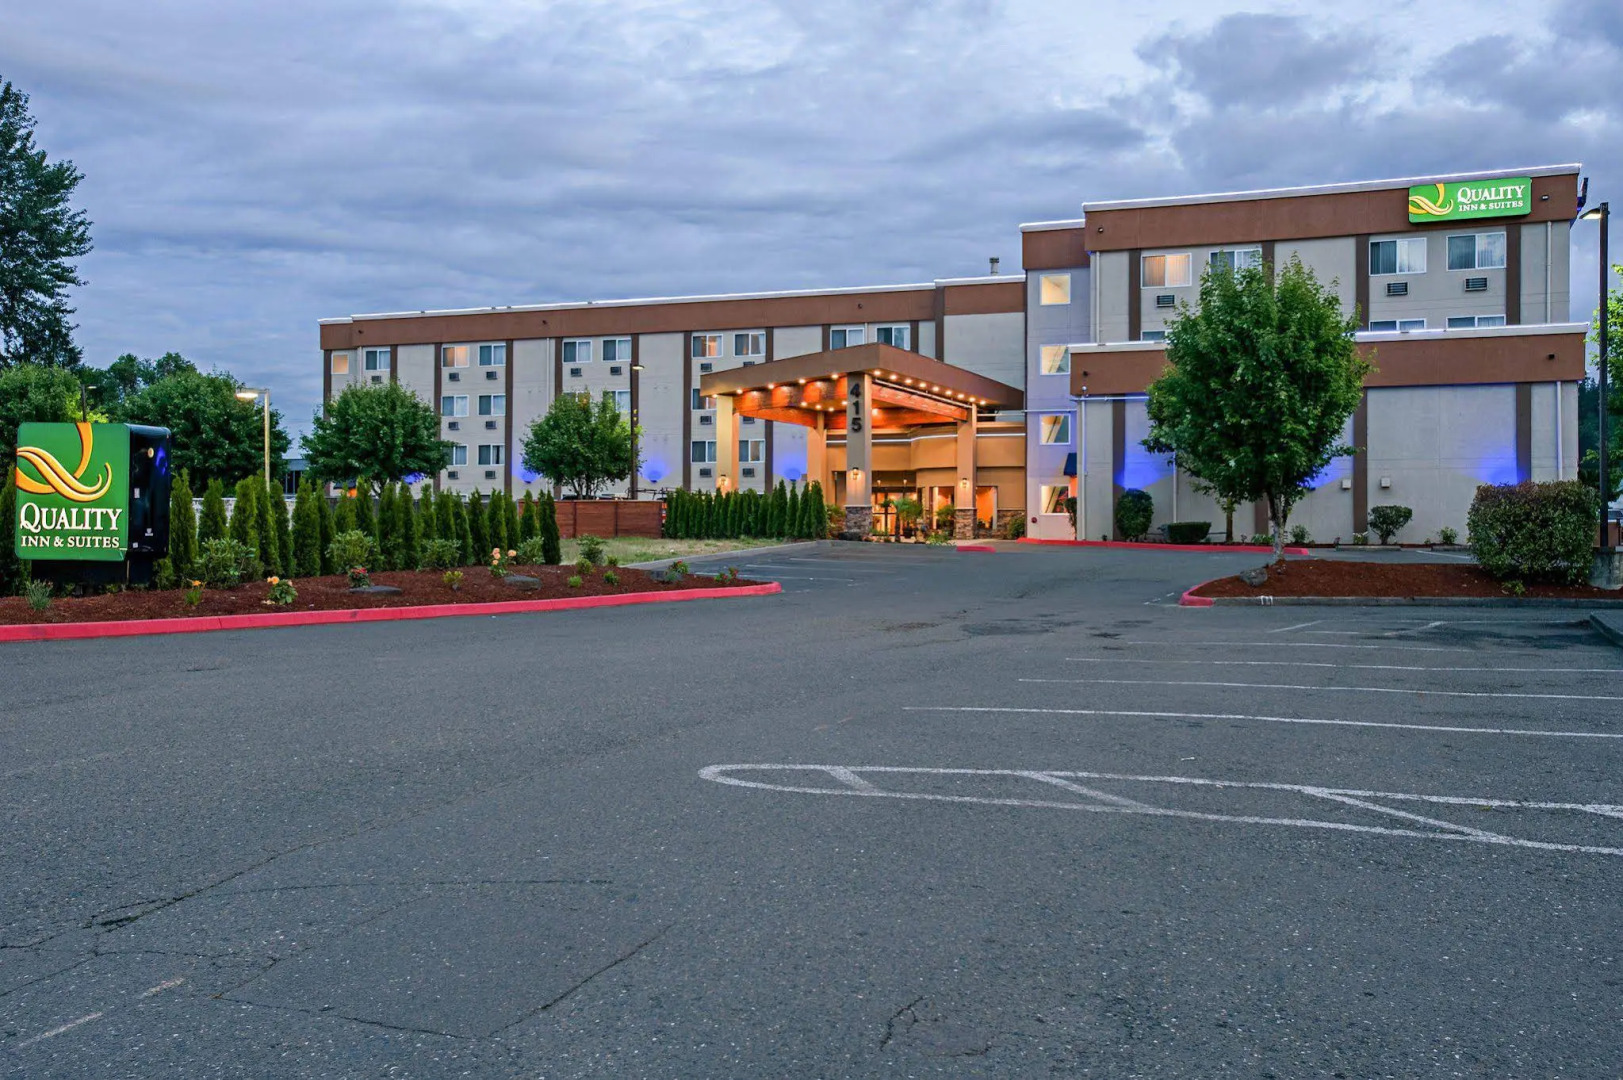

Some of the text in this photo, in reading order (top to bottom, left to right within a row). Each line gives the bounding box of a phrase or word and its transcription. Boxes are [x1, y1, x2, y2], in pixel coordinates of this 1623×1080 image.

[1457, 185, 1525, 204] QUALITY
[1459, 203, 1478, 212] INN
[1489, 200, 1523, 210] SUITES
[850, 383, 862, 433] 415
[20, 502, 122, 533] QUALITY
[21, 535, 120, 548] INN & SUITES
